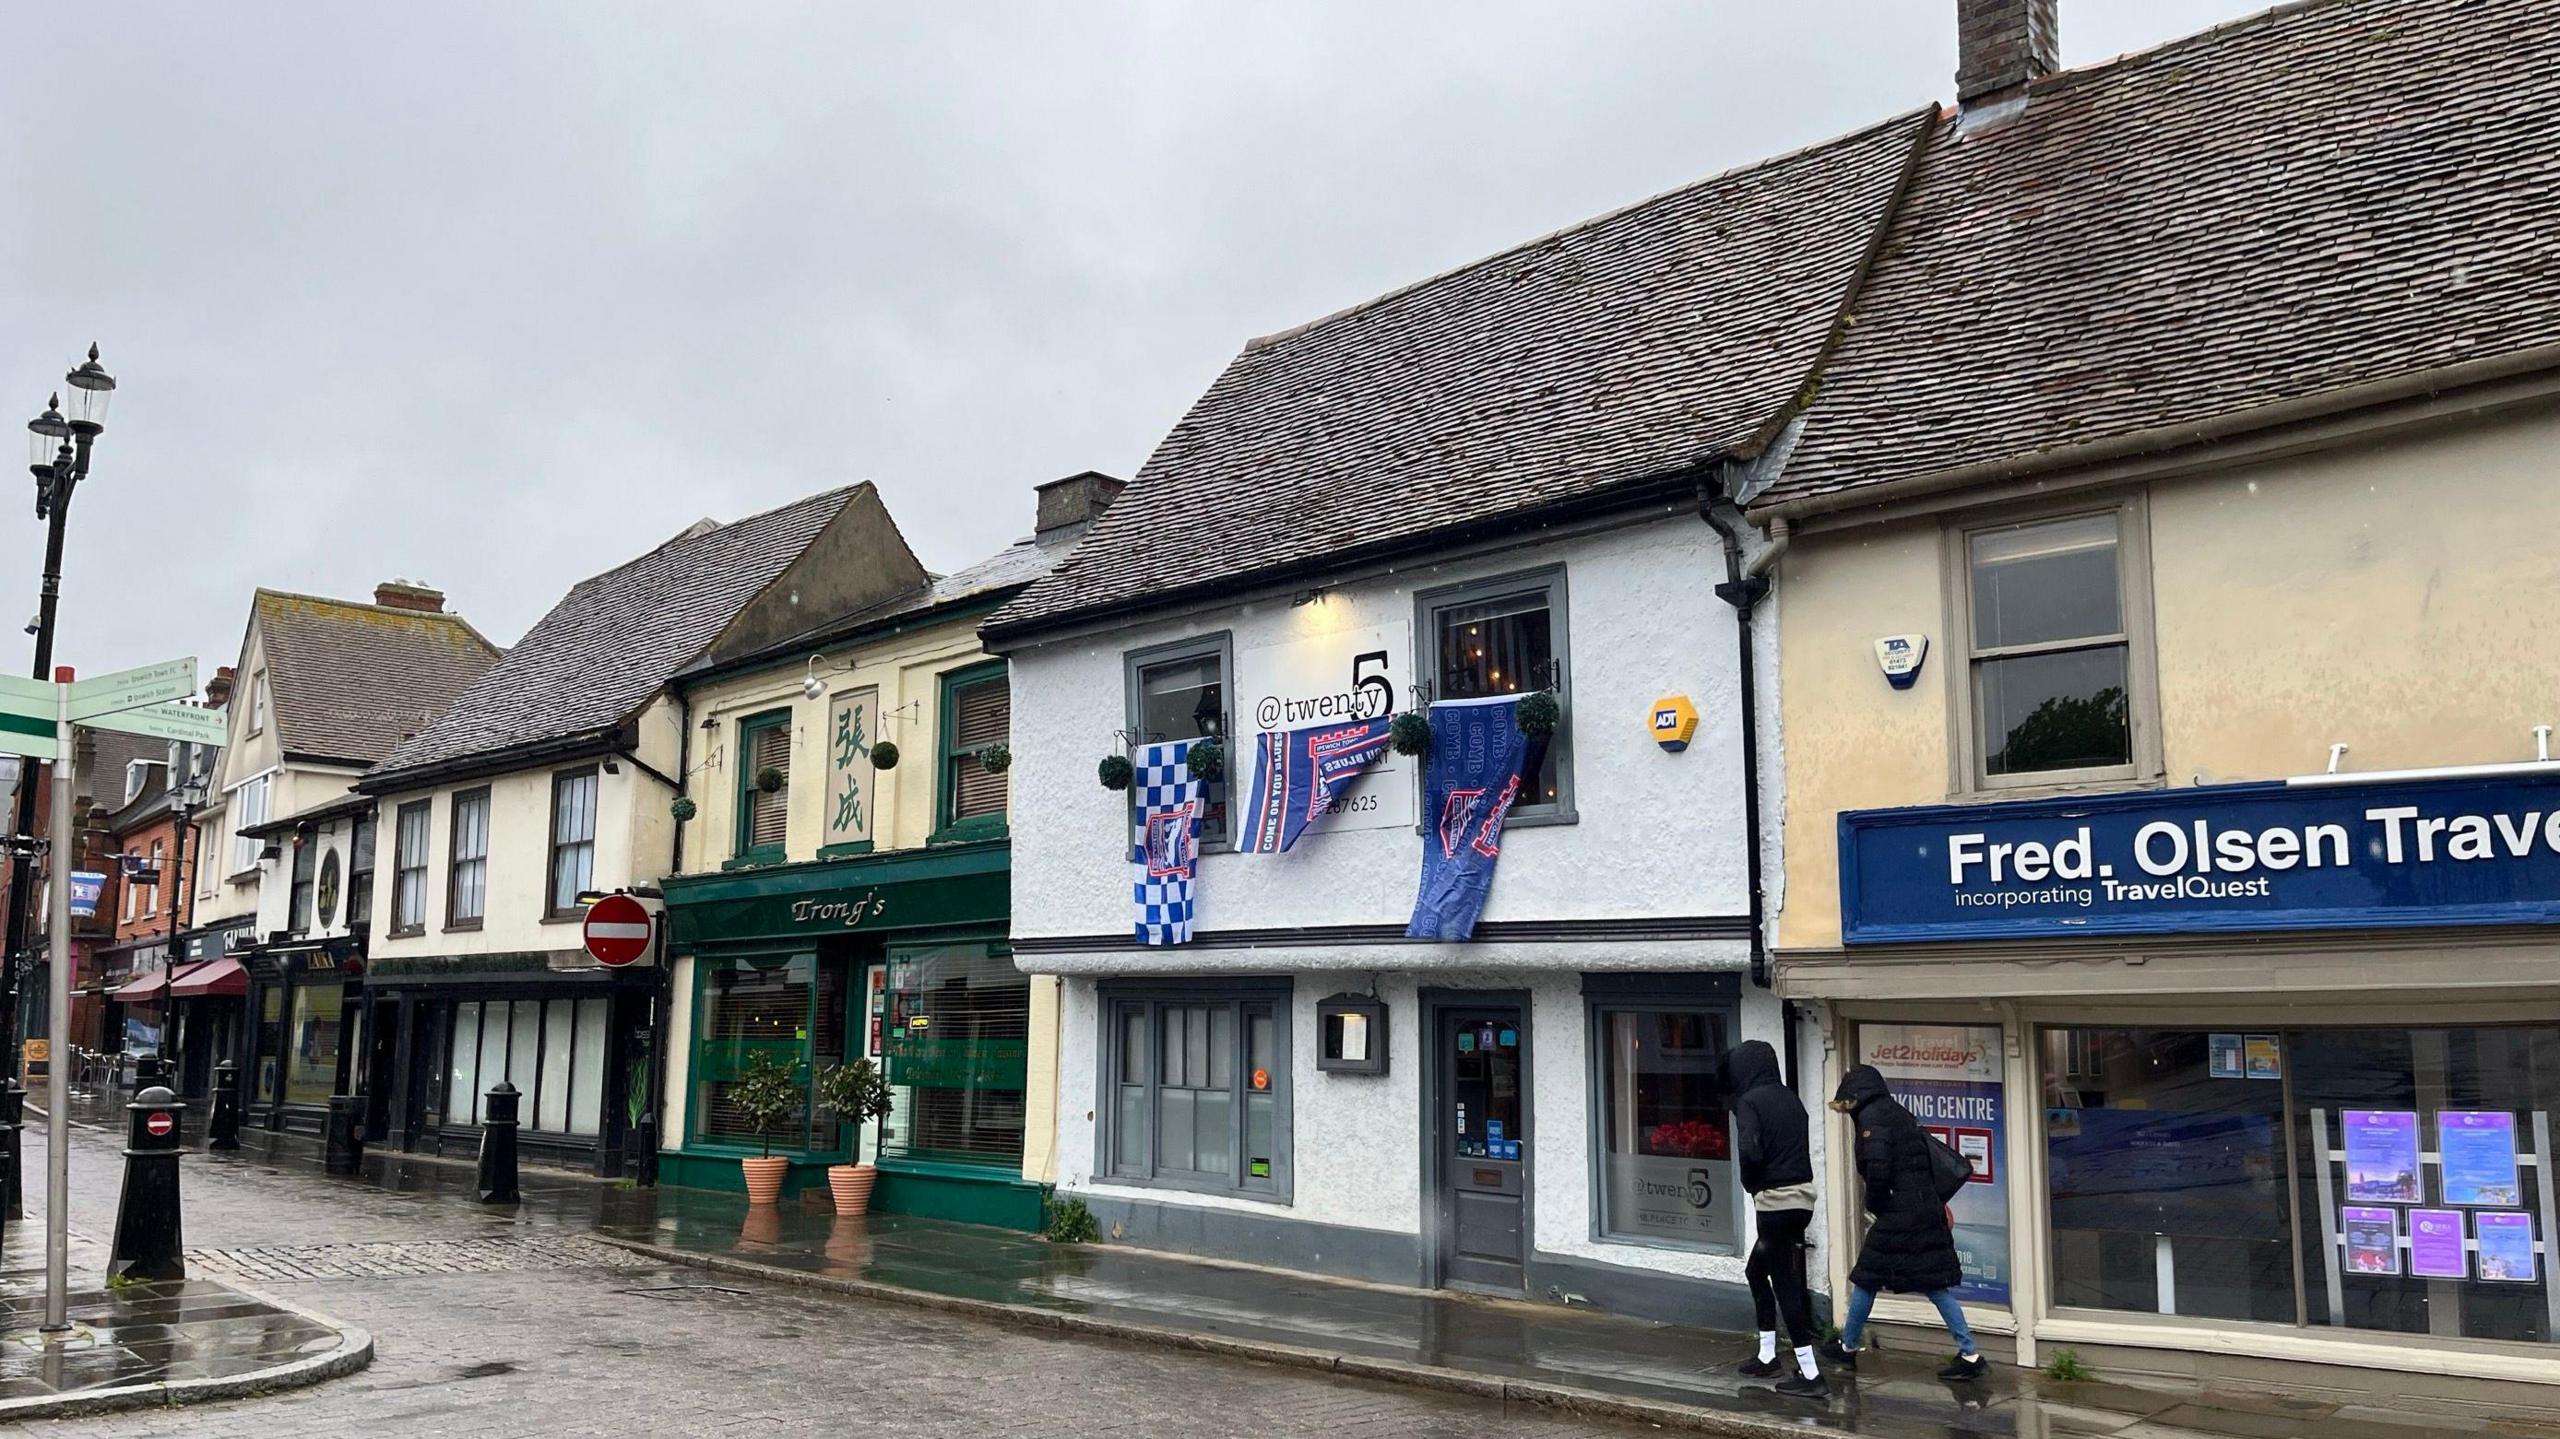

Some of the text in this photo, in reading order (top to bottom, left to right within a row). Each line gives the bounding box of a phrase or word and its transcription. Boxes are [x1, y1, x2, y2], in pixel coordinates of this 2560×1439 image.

[131, 672, 151, 684] Ipswich
[154, 668, 168, 678] Town
[170, 667, 177, 675] FC
[134, 687, 176, 702] Ipswich Station
[1256, 684, 1382, 729] @twenty
[161, 708, 210, 722] WATERFRONT
[1656, 713, 1676, 727] ADT
[167, 727, 195, 738] Cardinal
[195, 730, 210, 740] Park
[1317, 741, 1340, 752] IPSWICH
[1445, 708, 1461, 760] COYB
[1491, 706, 1507, 759] COYB
[1468, 722, 1485, 774] COYB
[1263, 732, 1283, 851] COME ON YOU BLUES
[1949, 827, 2113, 884] Fred.
[2134, 820, 2350, 876] Olsen
[1955, 875, 2270, 909] incorporating TravelQuest
[792, 890, 886, 926] Trong's
[1870, 1044, 1977, 1066] Jet2holidays
[1937, 1095, 1995, 1121] CENTRE
